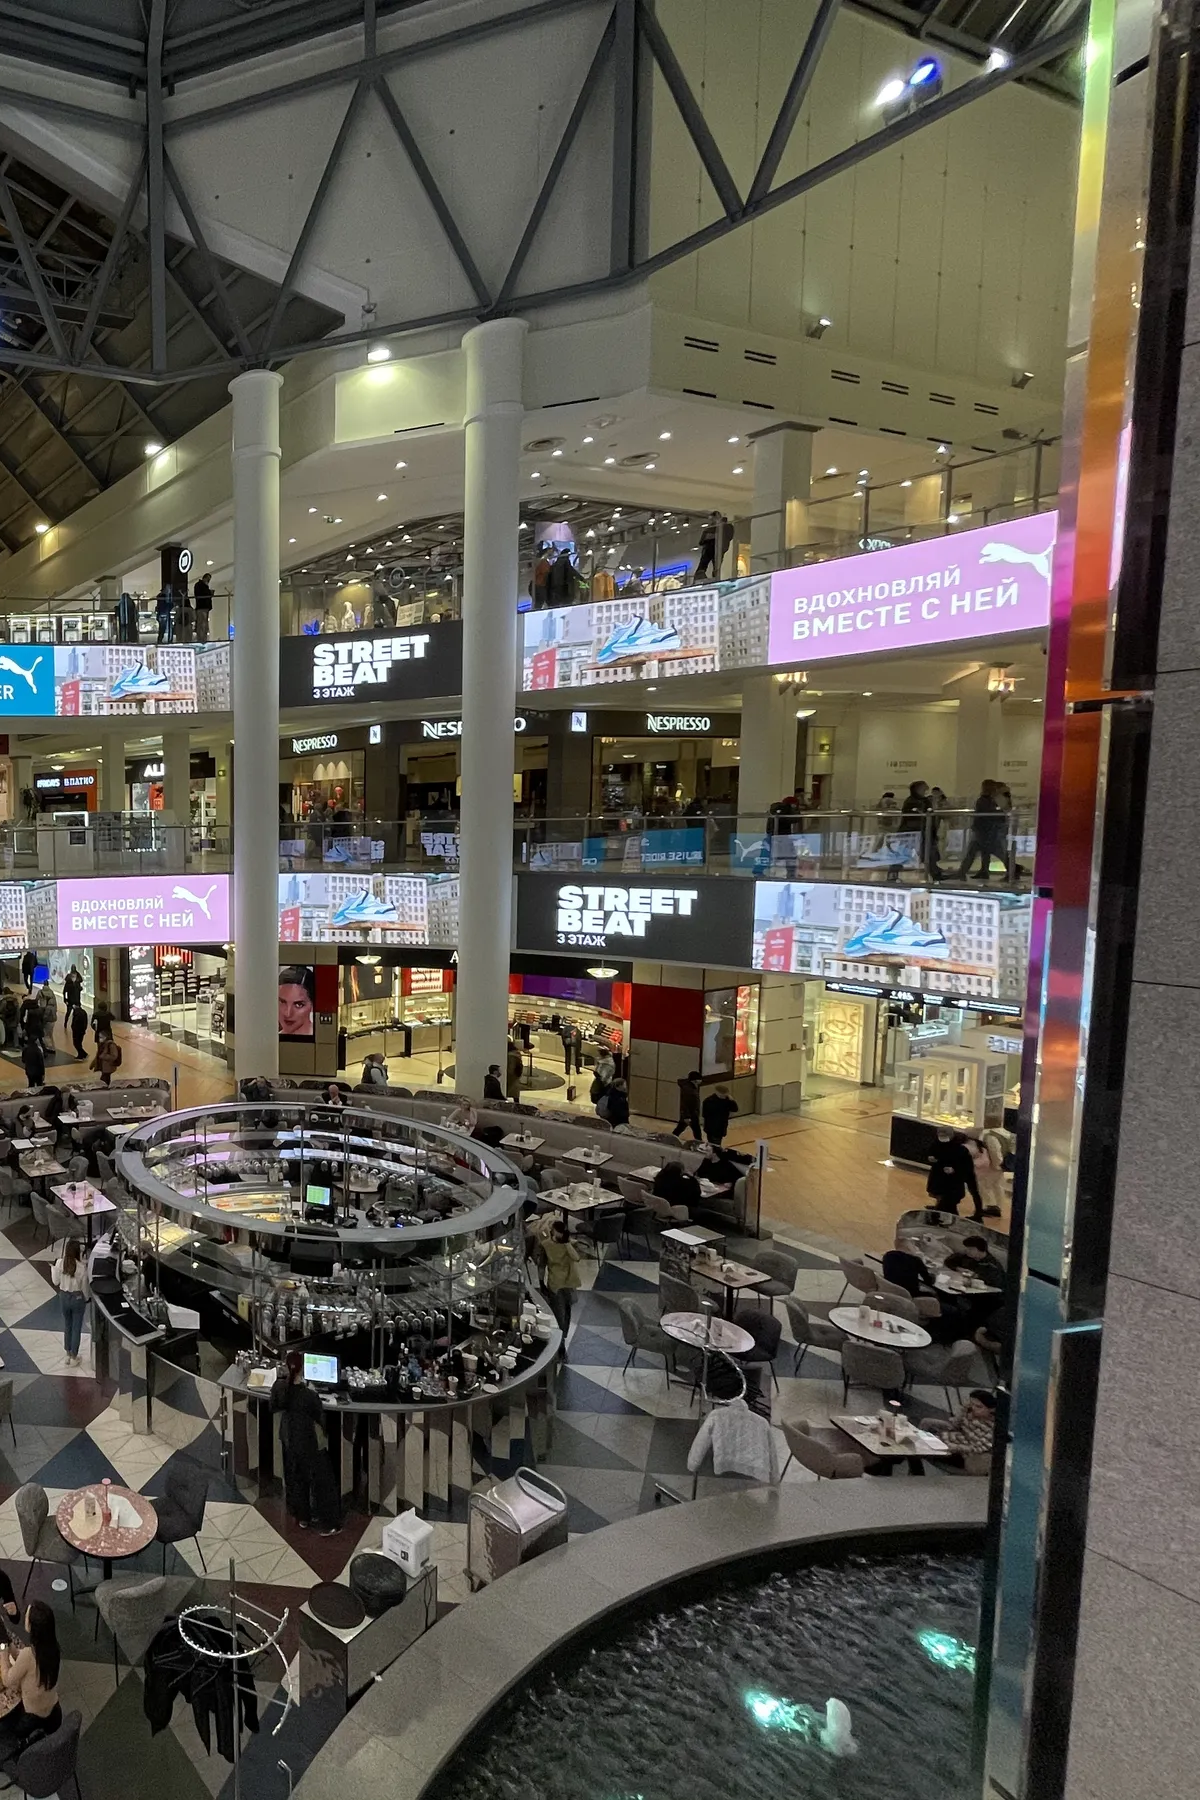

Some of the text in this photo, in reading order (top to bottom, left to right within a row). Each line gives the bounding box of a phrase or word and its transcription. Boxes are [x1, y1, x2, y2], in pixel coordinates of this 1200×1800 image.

[794, 563, 961, 615] ВДОХНОВЛЯЙ
[793, 577, 1019, 640] ВМЕСТЕ С НЕЙ
[313, 634, 430, 666] STREET
[313, 660, 392, 687] BEAT
[313, 686, 355, 699] 3 ЭТАЖ
[646, 713, 710, 733] NESPRESSO
[292, 735, 338, 754] NESPRESSO
[72, 895, 164, 914] ВДОХНОВЛЯЙ
[558, 885, 698, 916] STREET
[72, 909, 194, 930] ВМЕСТЕ С НЕЙ
[558, 909, 651, 937] BEAT
[557, 934, 606, 947] 3 ЭТАЖ
